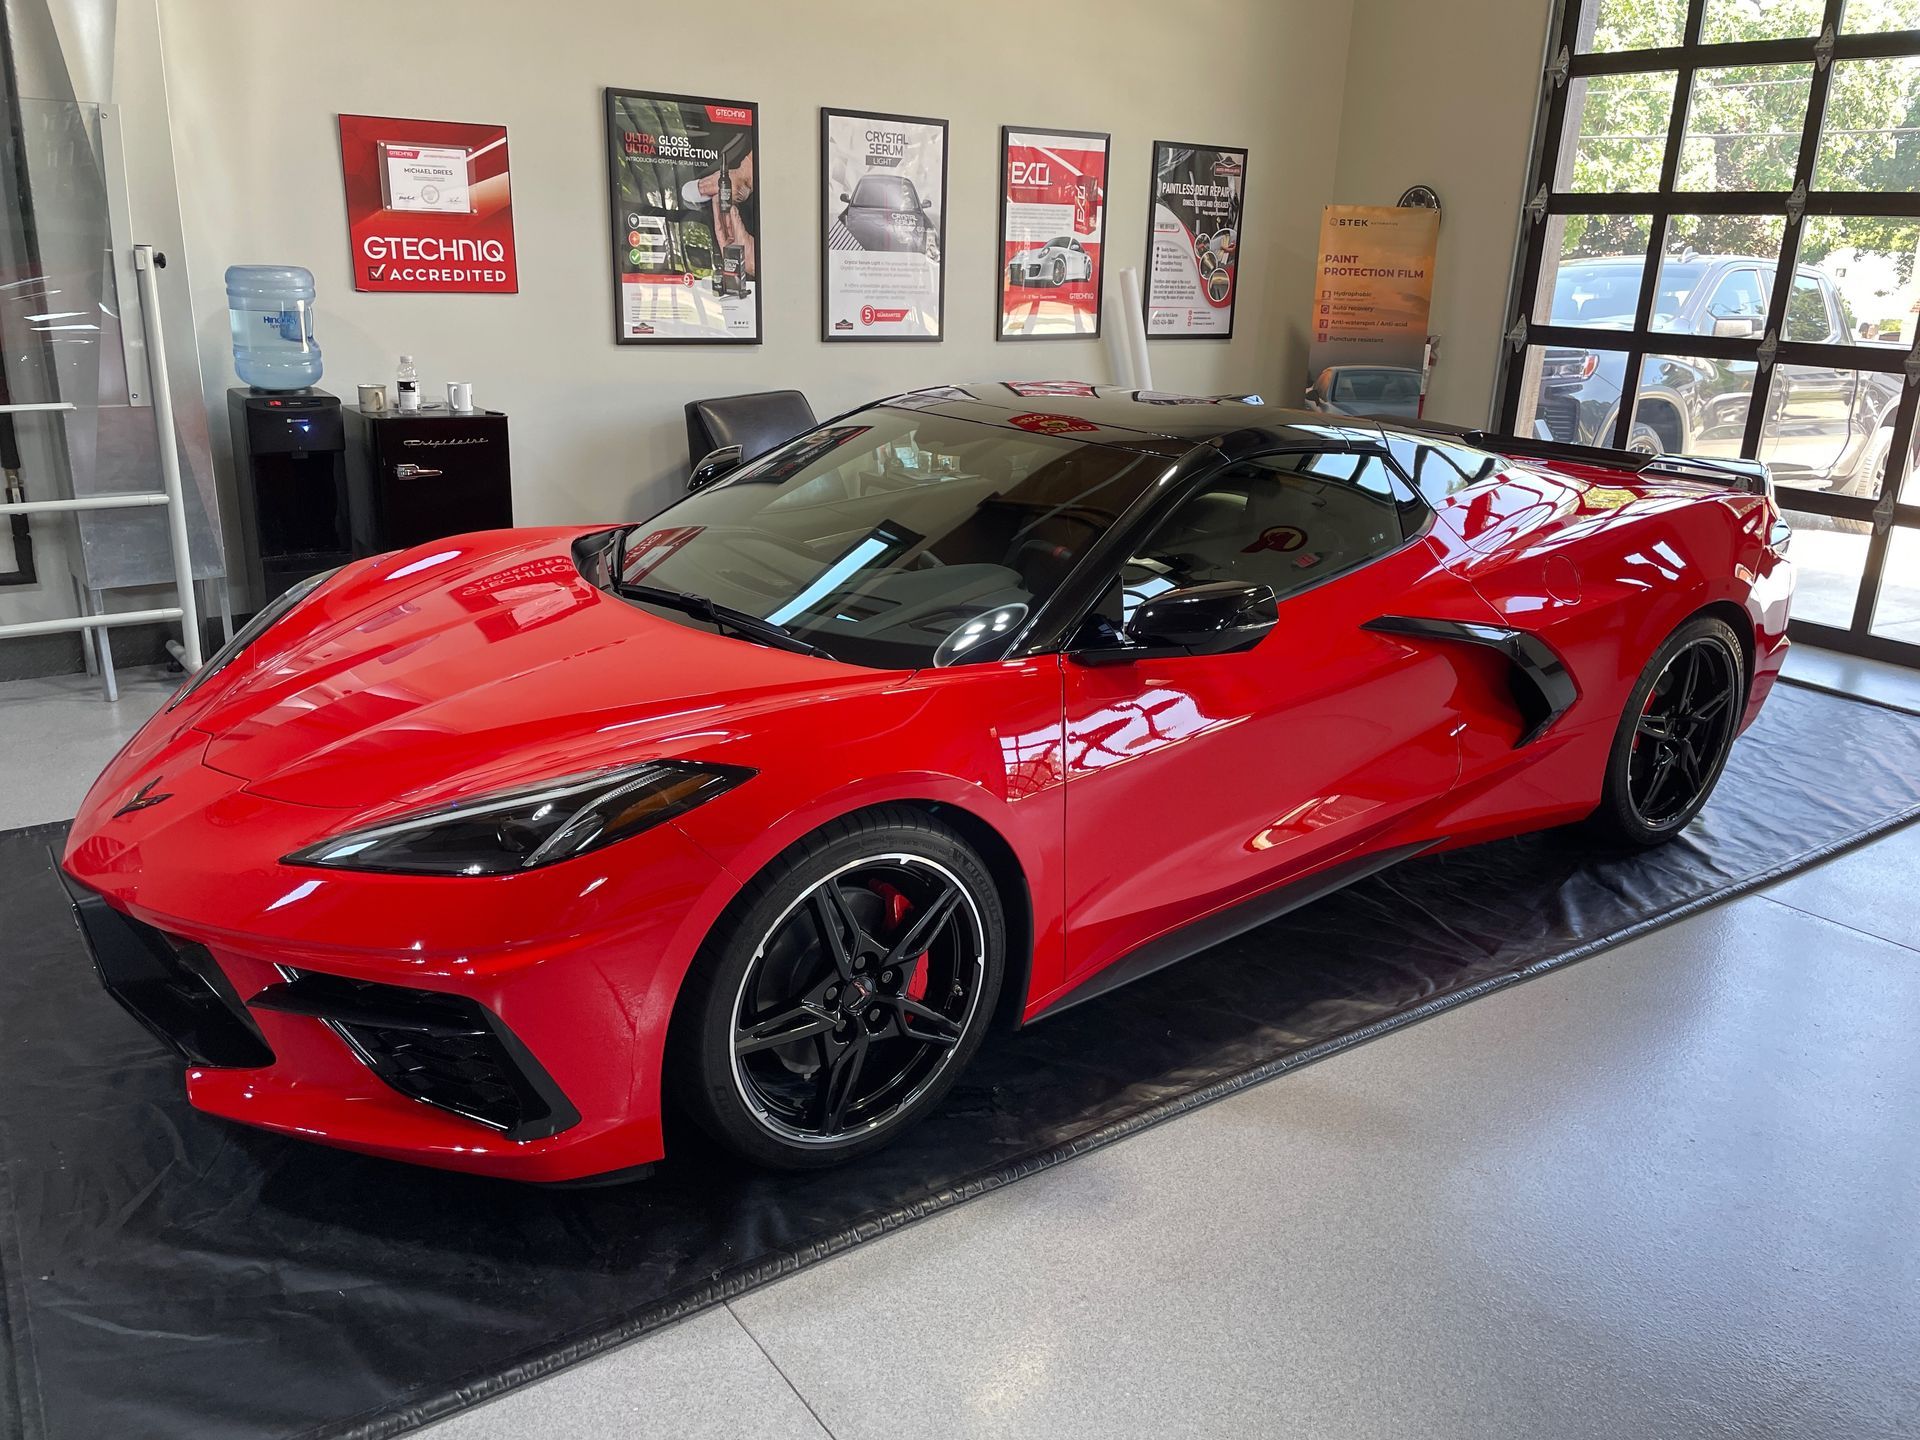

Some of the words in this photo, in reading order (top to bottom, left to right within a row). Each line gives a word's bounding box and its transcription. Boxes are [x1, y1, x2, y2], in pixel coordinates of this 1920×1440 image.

[716, 109, 746, 118] GTECHNIQ
[624, 132, 656, 144] ULTRA
[658, 135, 692, 148] GLOSS,
[865, 130, 909, 145] CRYSTAL
[625, 143, 656, 155] ULTRA
[658, 146, 718, 160] PROTECTION
[869, 143, 904, 156] SERUM
[626, 156, 658, 164] INTRODUCING
[404, 167, 432, 175] MICHAEL
[1162, 182, 1194, 195] PAINTLESS
[1194, 184, 1210, 196] DENT
[1210, 185, 1230, 197] REPAIR
[364, 236, 505, 262] GTECHNIQ
[1325, 254, 1359, 264] PAINT
[390, 268, 506, 282] ACCREDITED
[1324, 267, 1394, 278] PROTECTION
[1398, 270, 1424, 279] FILM
[865, 310, 871, 319] 5
[403, 437, 489, 448] Frigidaire
